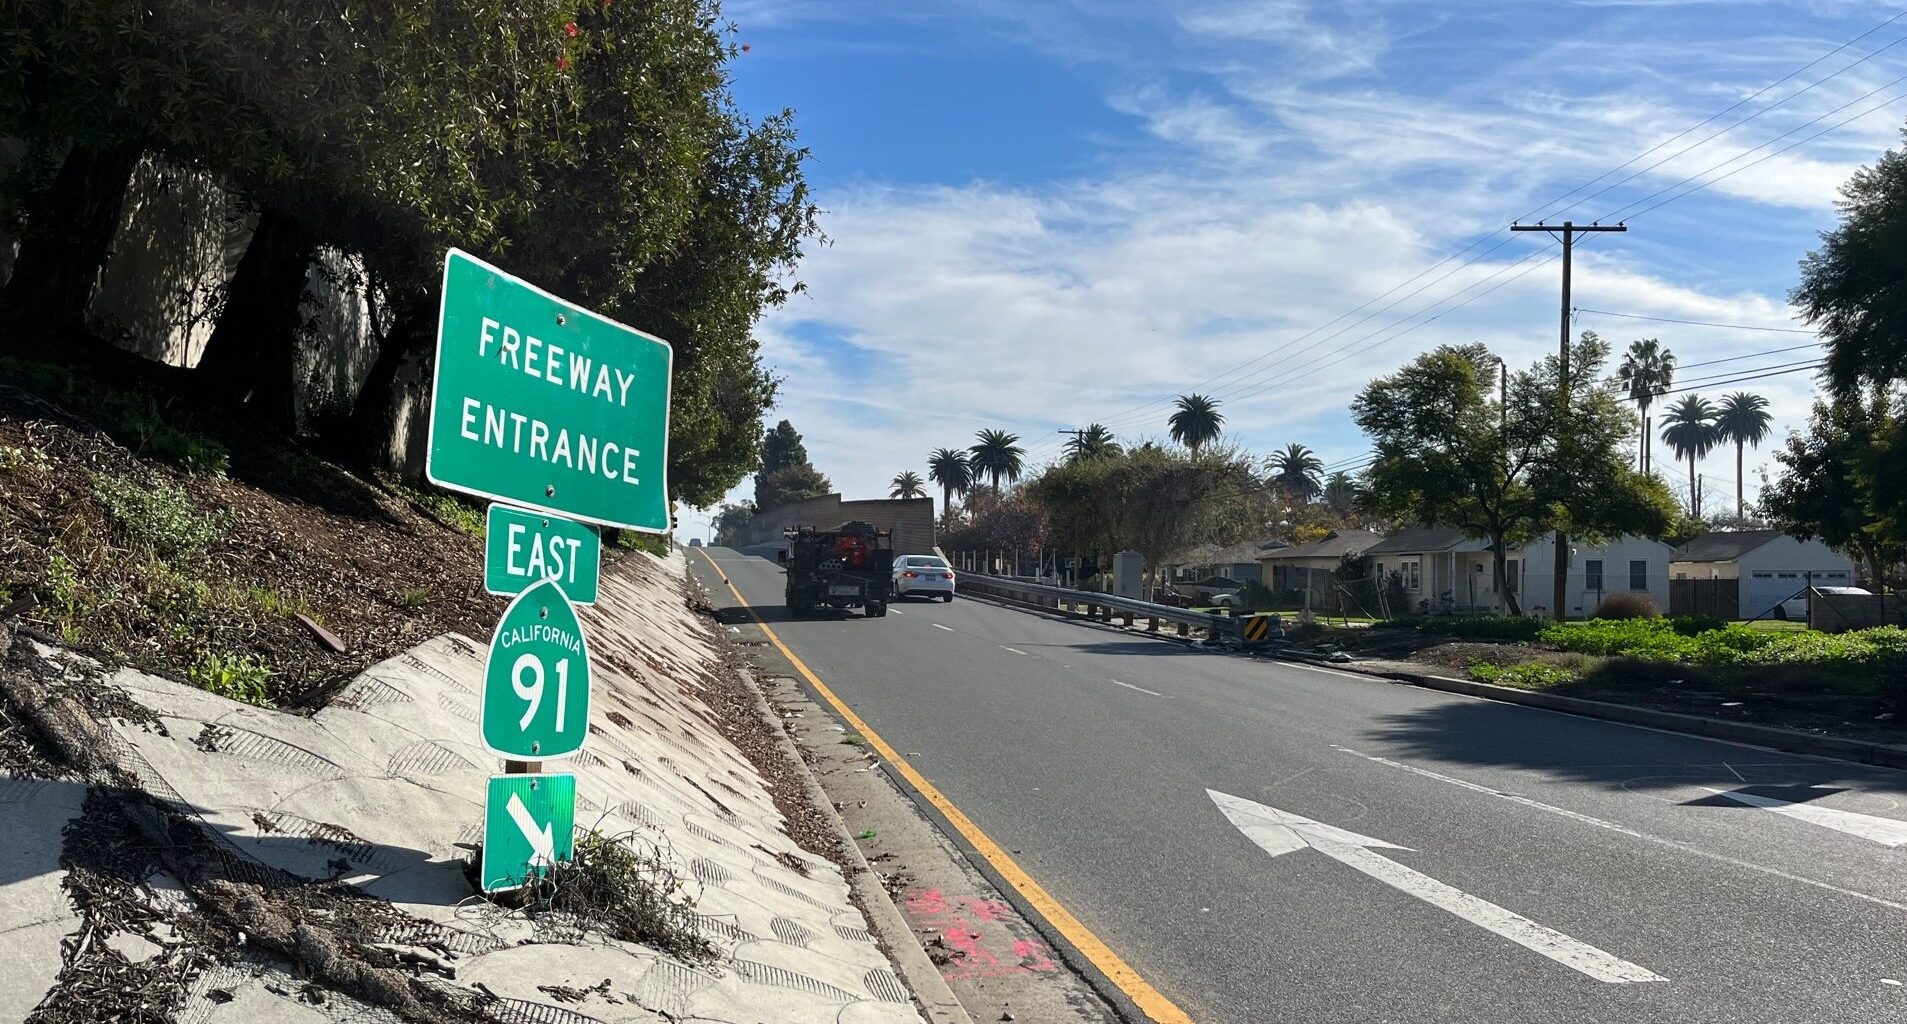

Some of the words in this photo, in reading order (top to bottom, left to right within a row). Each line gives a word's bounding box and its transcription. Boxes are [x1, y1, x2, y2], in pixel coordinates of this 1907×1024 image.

[479, 316, 635, 407] FREEWAY
[461, 396, 640, 485] ENTRANCE
[507, 523, 581, 583] EAST
[501, 624, 580, 656] CALIFORNIA
[511, 653, 569, 733] 91
